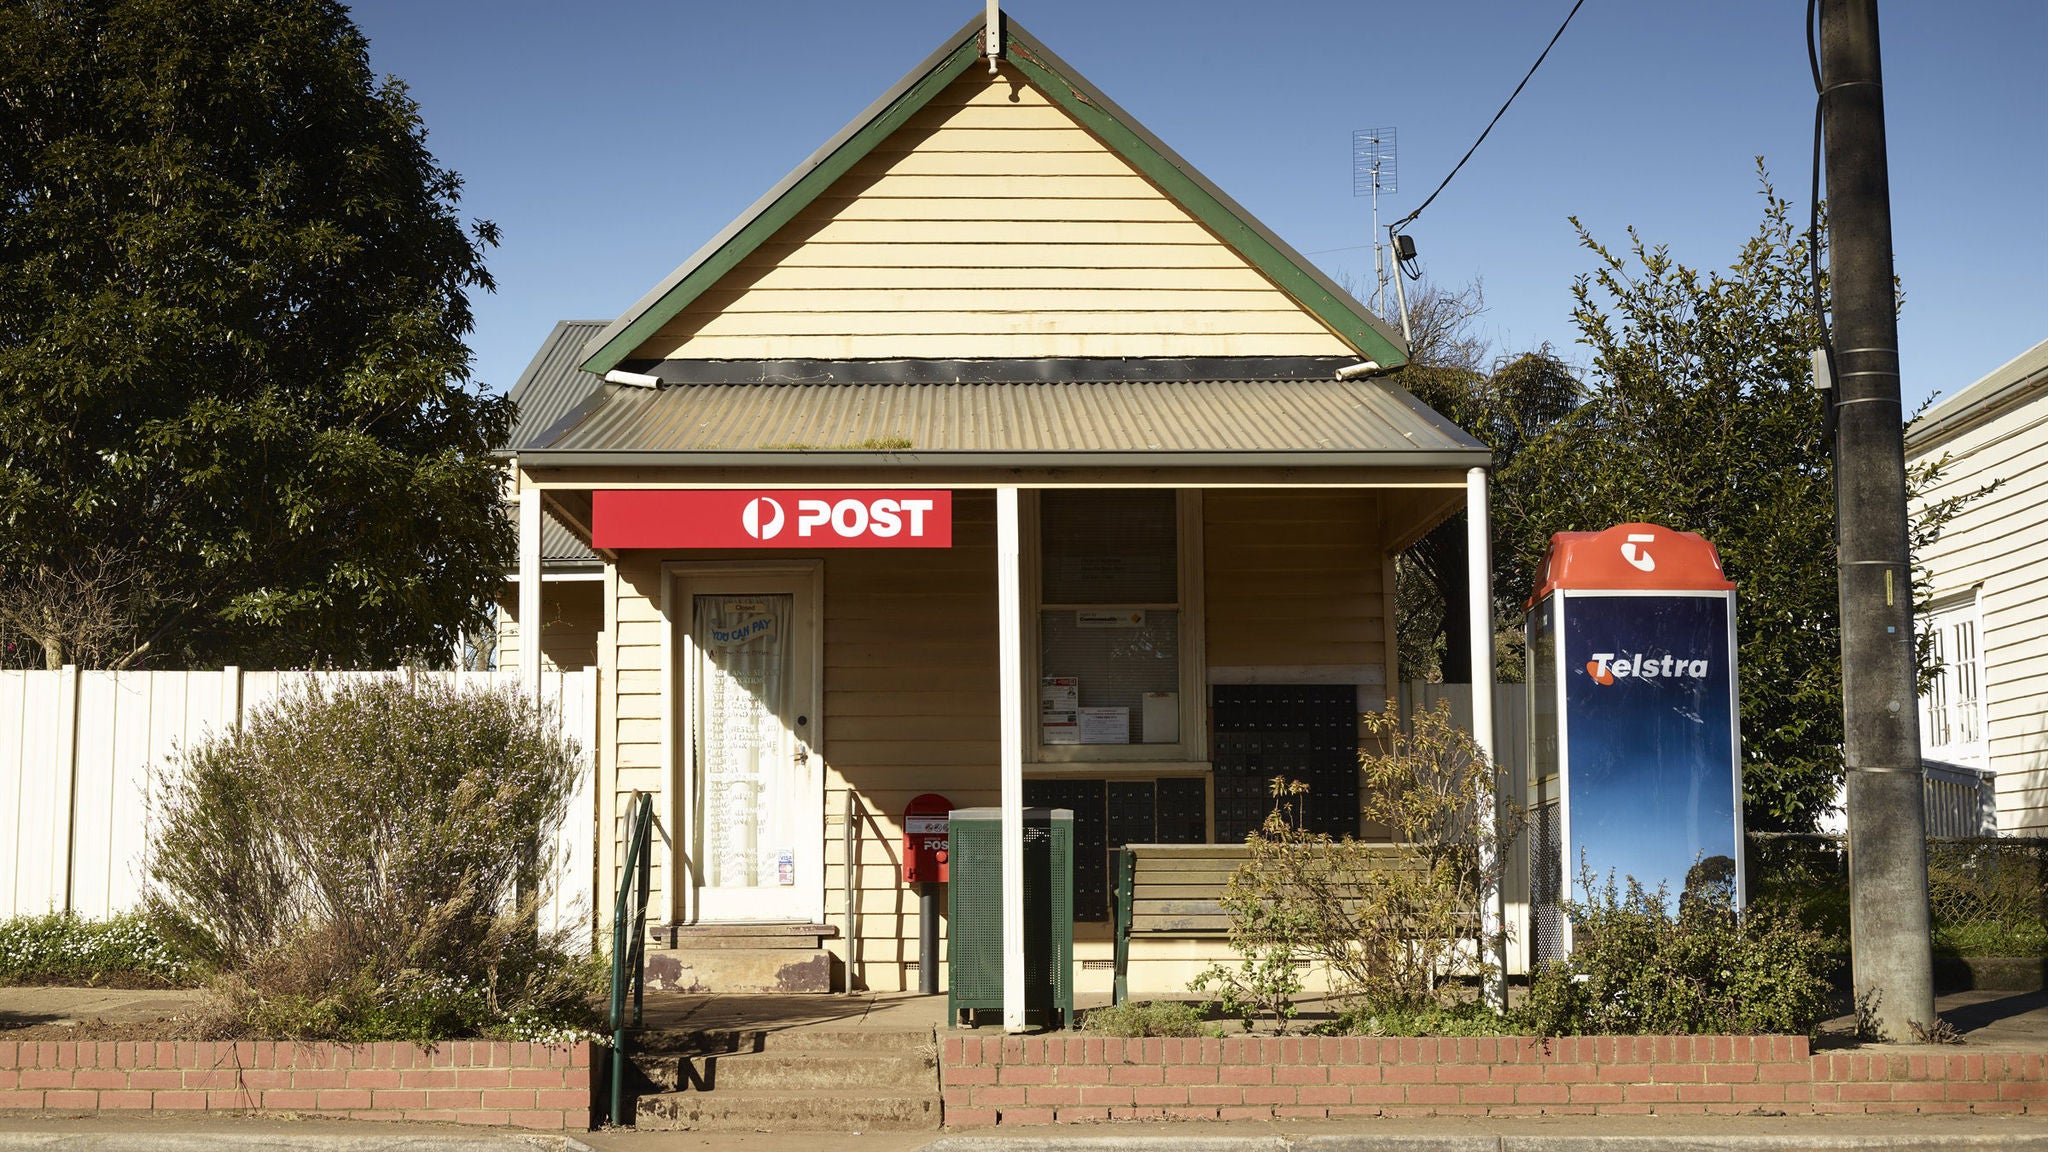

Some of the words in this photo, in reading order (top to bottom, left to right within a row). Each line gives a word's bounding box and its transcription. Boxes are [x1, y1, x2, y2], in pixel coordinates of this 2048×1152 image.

[798, 498, 933, 538] POST
[712, 629, 730, 642] YOU
[731, 626, 750, 641] CAN
[752, 619, 772, 632] PAY
[1587, 653, 1708, 678] Telstra
[924, 840, 949, 851] POS
